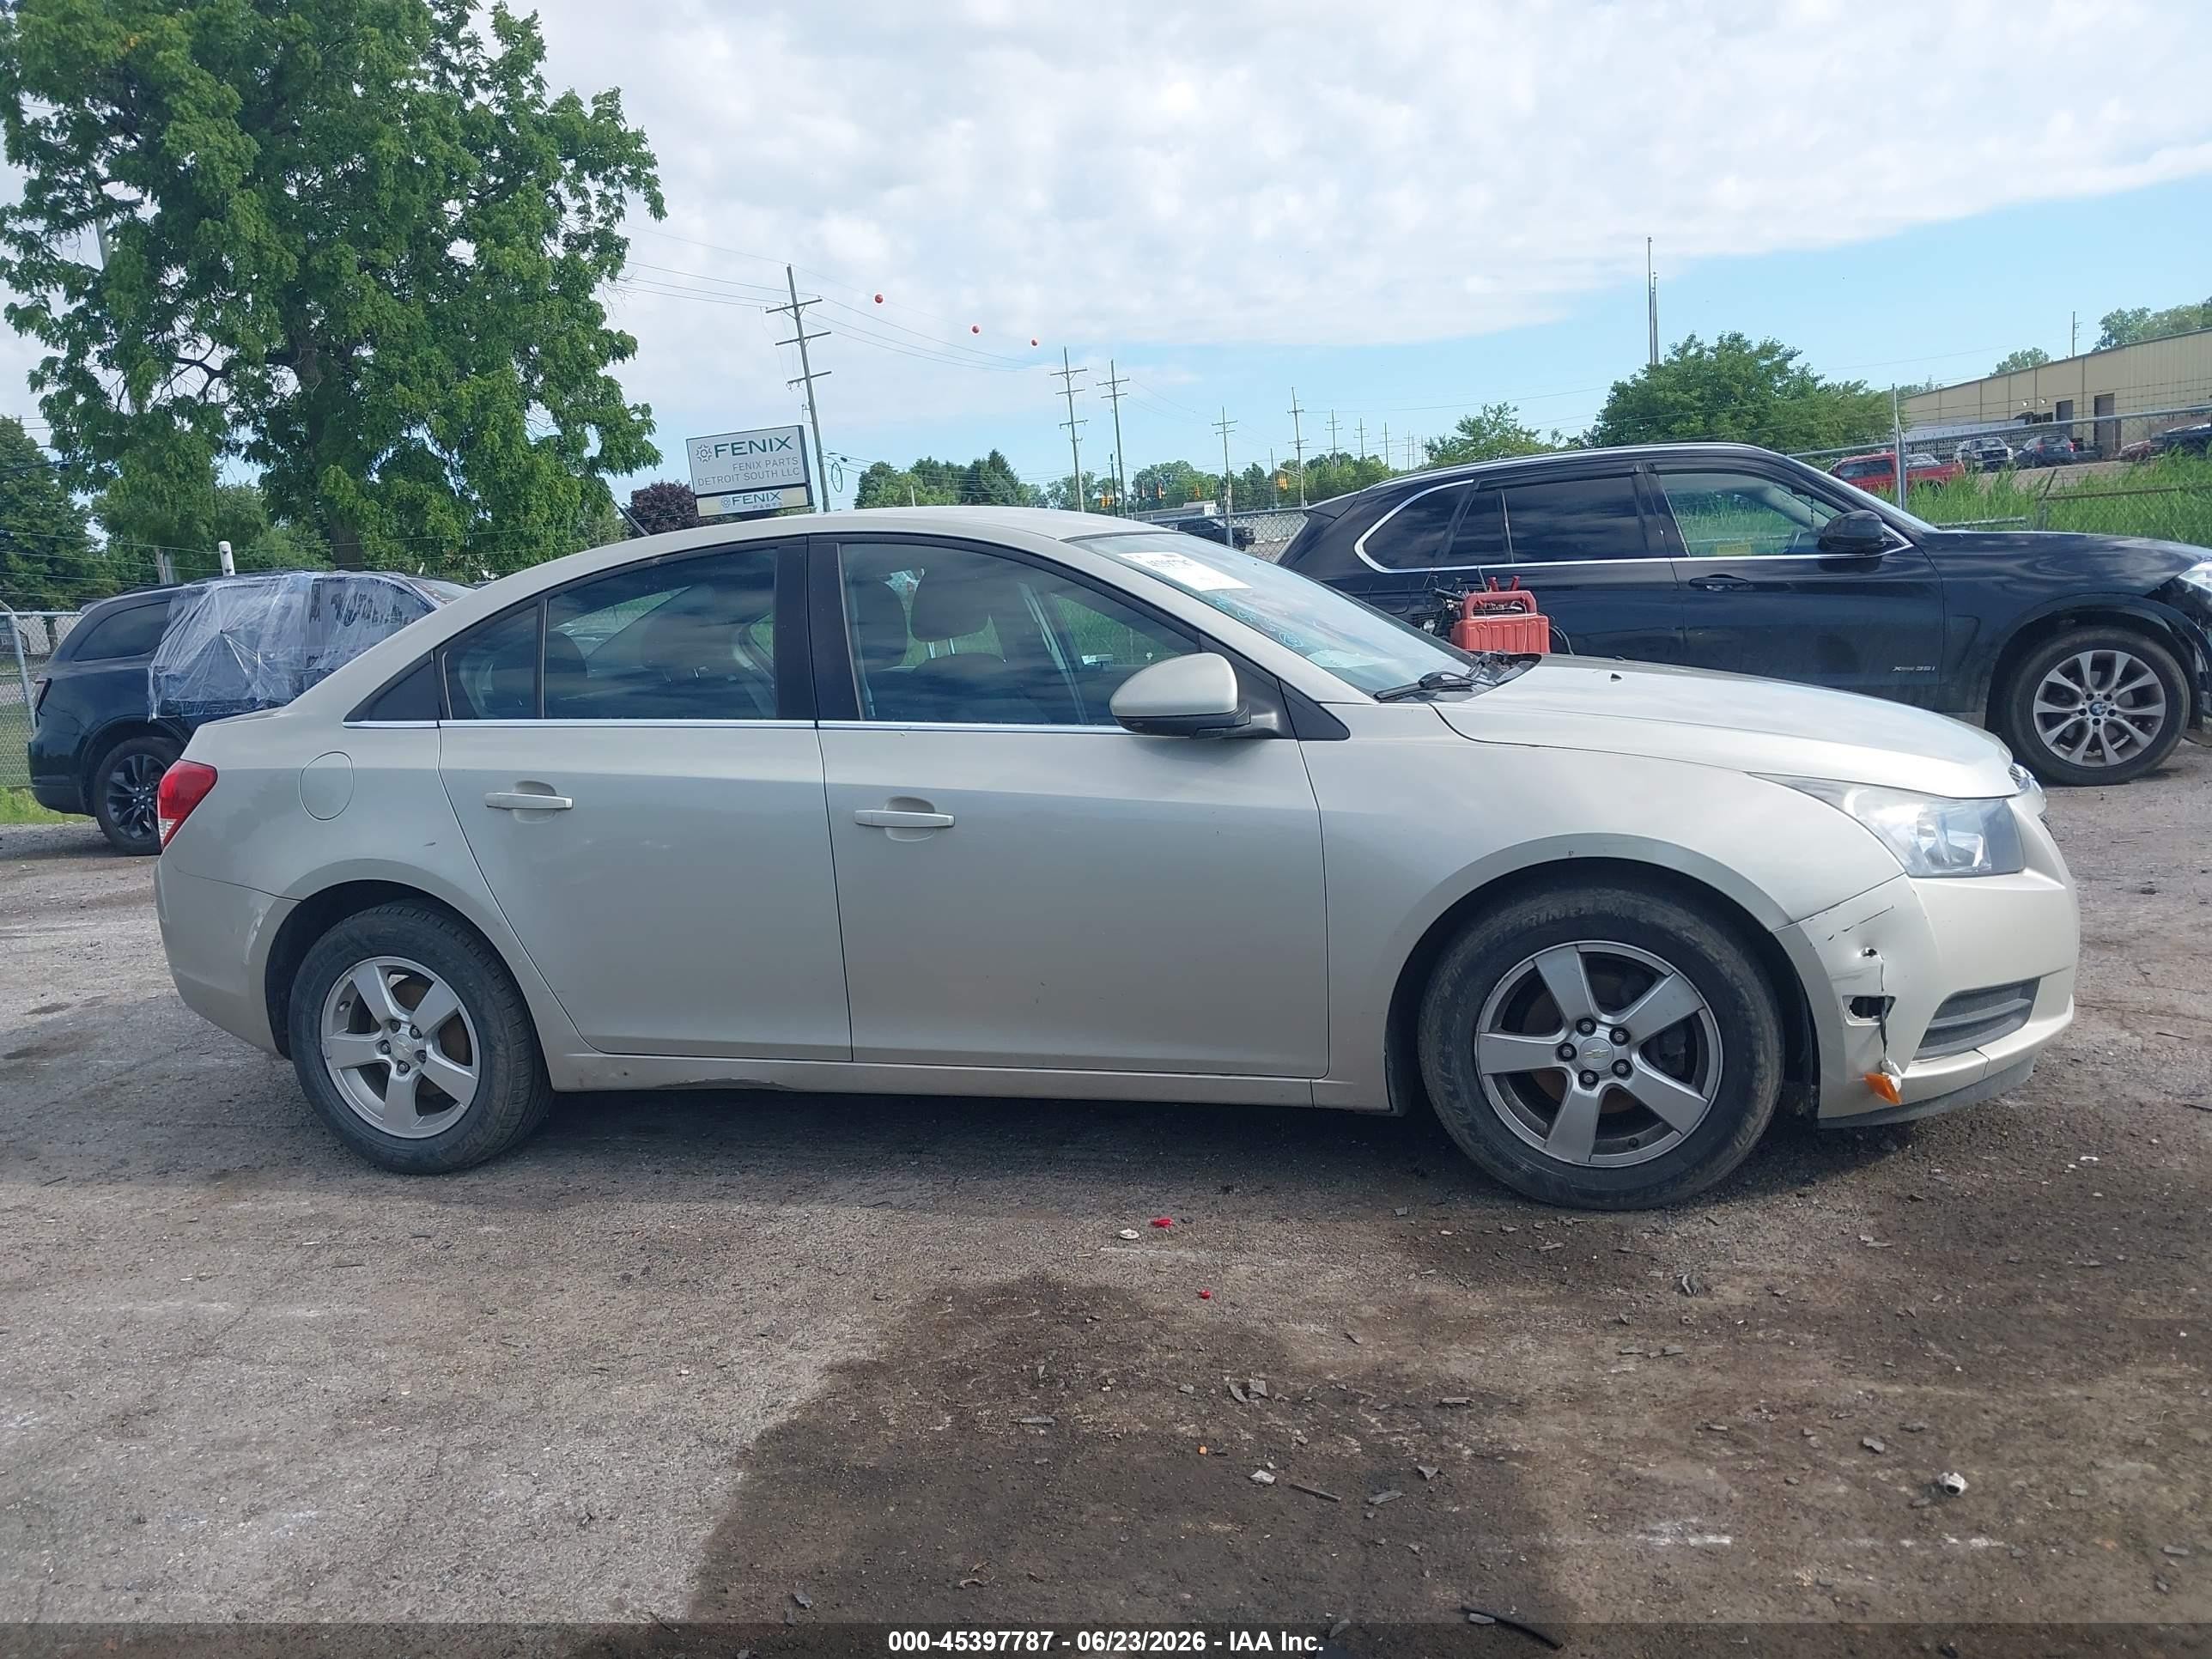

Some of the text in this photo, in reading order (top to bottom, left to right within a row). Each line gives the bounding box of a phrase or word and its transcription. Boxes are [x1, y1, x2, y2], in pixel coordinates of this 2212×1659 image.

[714, 435, 793, 458] FENIX
[732, 457, 799, 471] FENIX PARTS
[697, 467, 800, 487] DETROIT SOUTH LLC
[732, 491, 782, 506] FENIX
